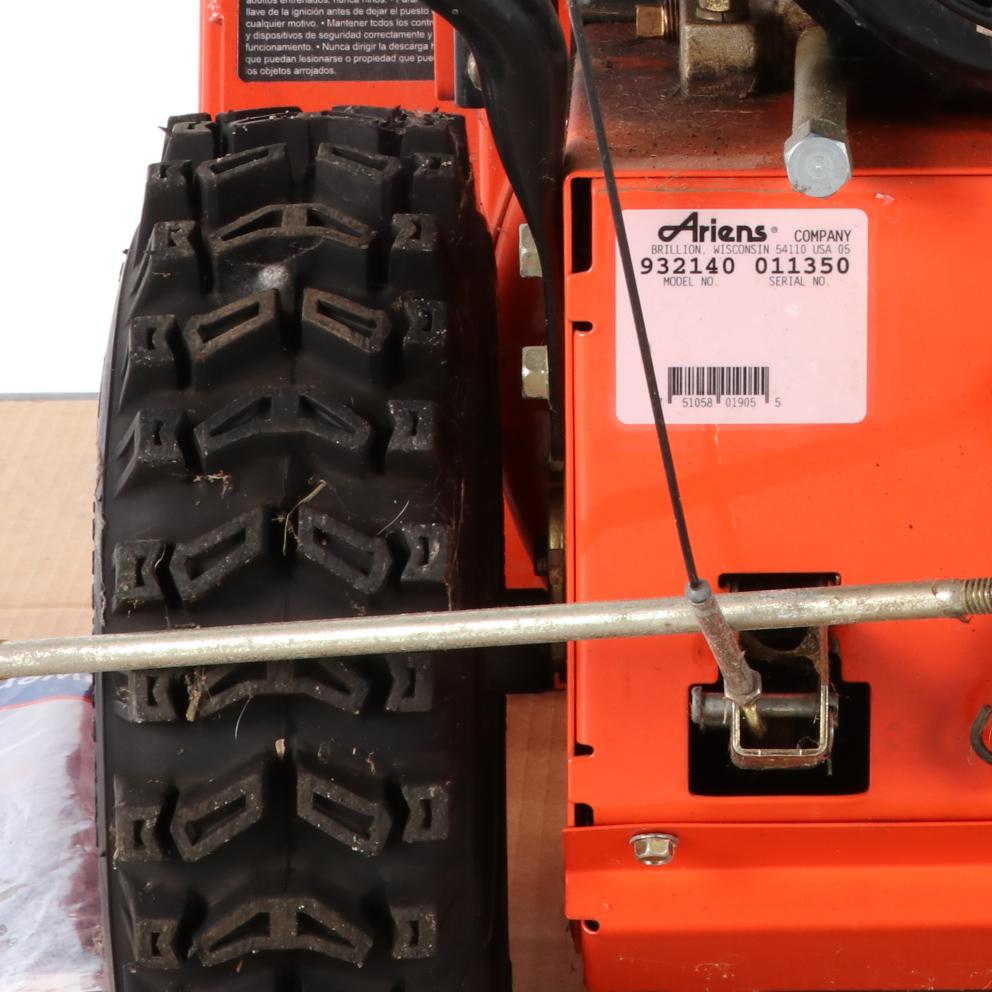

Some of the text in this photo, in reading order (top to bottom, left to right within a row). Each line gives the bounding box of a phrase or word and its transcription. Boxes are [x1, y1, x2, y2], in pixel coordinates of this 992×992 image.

[245, 8, 266, 16] llave
[268, 8, 279, 16] de
[281, 8, 290, 16] la
[291, 8, 325, 18] ignición
[327, 8, 351, 16] antes
[353, 8, 364, 16] de
[366, 8, 388, 18] dejar
[390, 8, 398, 16] el
[400, 8, 430, 18] puesto
[245, 20, 286, 30] cualquier
[287, 20, 319, 28] motivo.
[326, 19, 368, 28] Mantener
[370, 19, 394, 27] todos
[396, 19, 409, 27] los
[245, 31, 433, 42] y dispositivos de seguridad correctamente y
[245, 43, 314, 52] funcionamiento.
[321, 43, 351, 51] Nunca
[352, 43, 377, 53] dirigir
[379, 43, 387, 51] la
[388, 43, 429, 53] descarga
[245, 56, 262, 65] que
[264, 55, 297, 65] puedan
[298, 54, 344, 63] lesionarse
[353, 54, 397, 65] propiedad
[399, 56, 415, 65] que
[260, 67, 292, 77] objetos
[293, 67, 336, 77] arrojados.
[658, 212, 852, 243] Ariens COMPANY
[713, 244, 770, 255] WISCONSIN
[776, 244, 807, 255] 54110
[812, 244, 832, 255] USA
[838, 244, 851, 255] 05
[640, 257, 850, 275] 932140 011350
[663, 276, 719, 286] MODEL NO.
[769, 276, 830, 286] SERIAL NO.
[682, 397, 782, 408] 51058 01905 5
